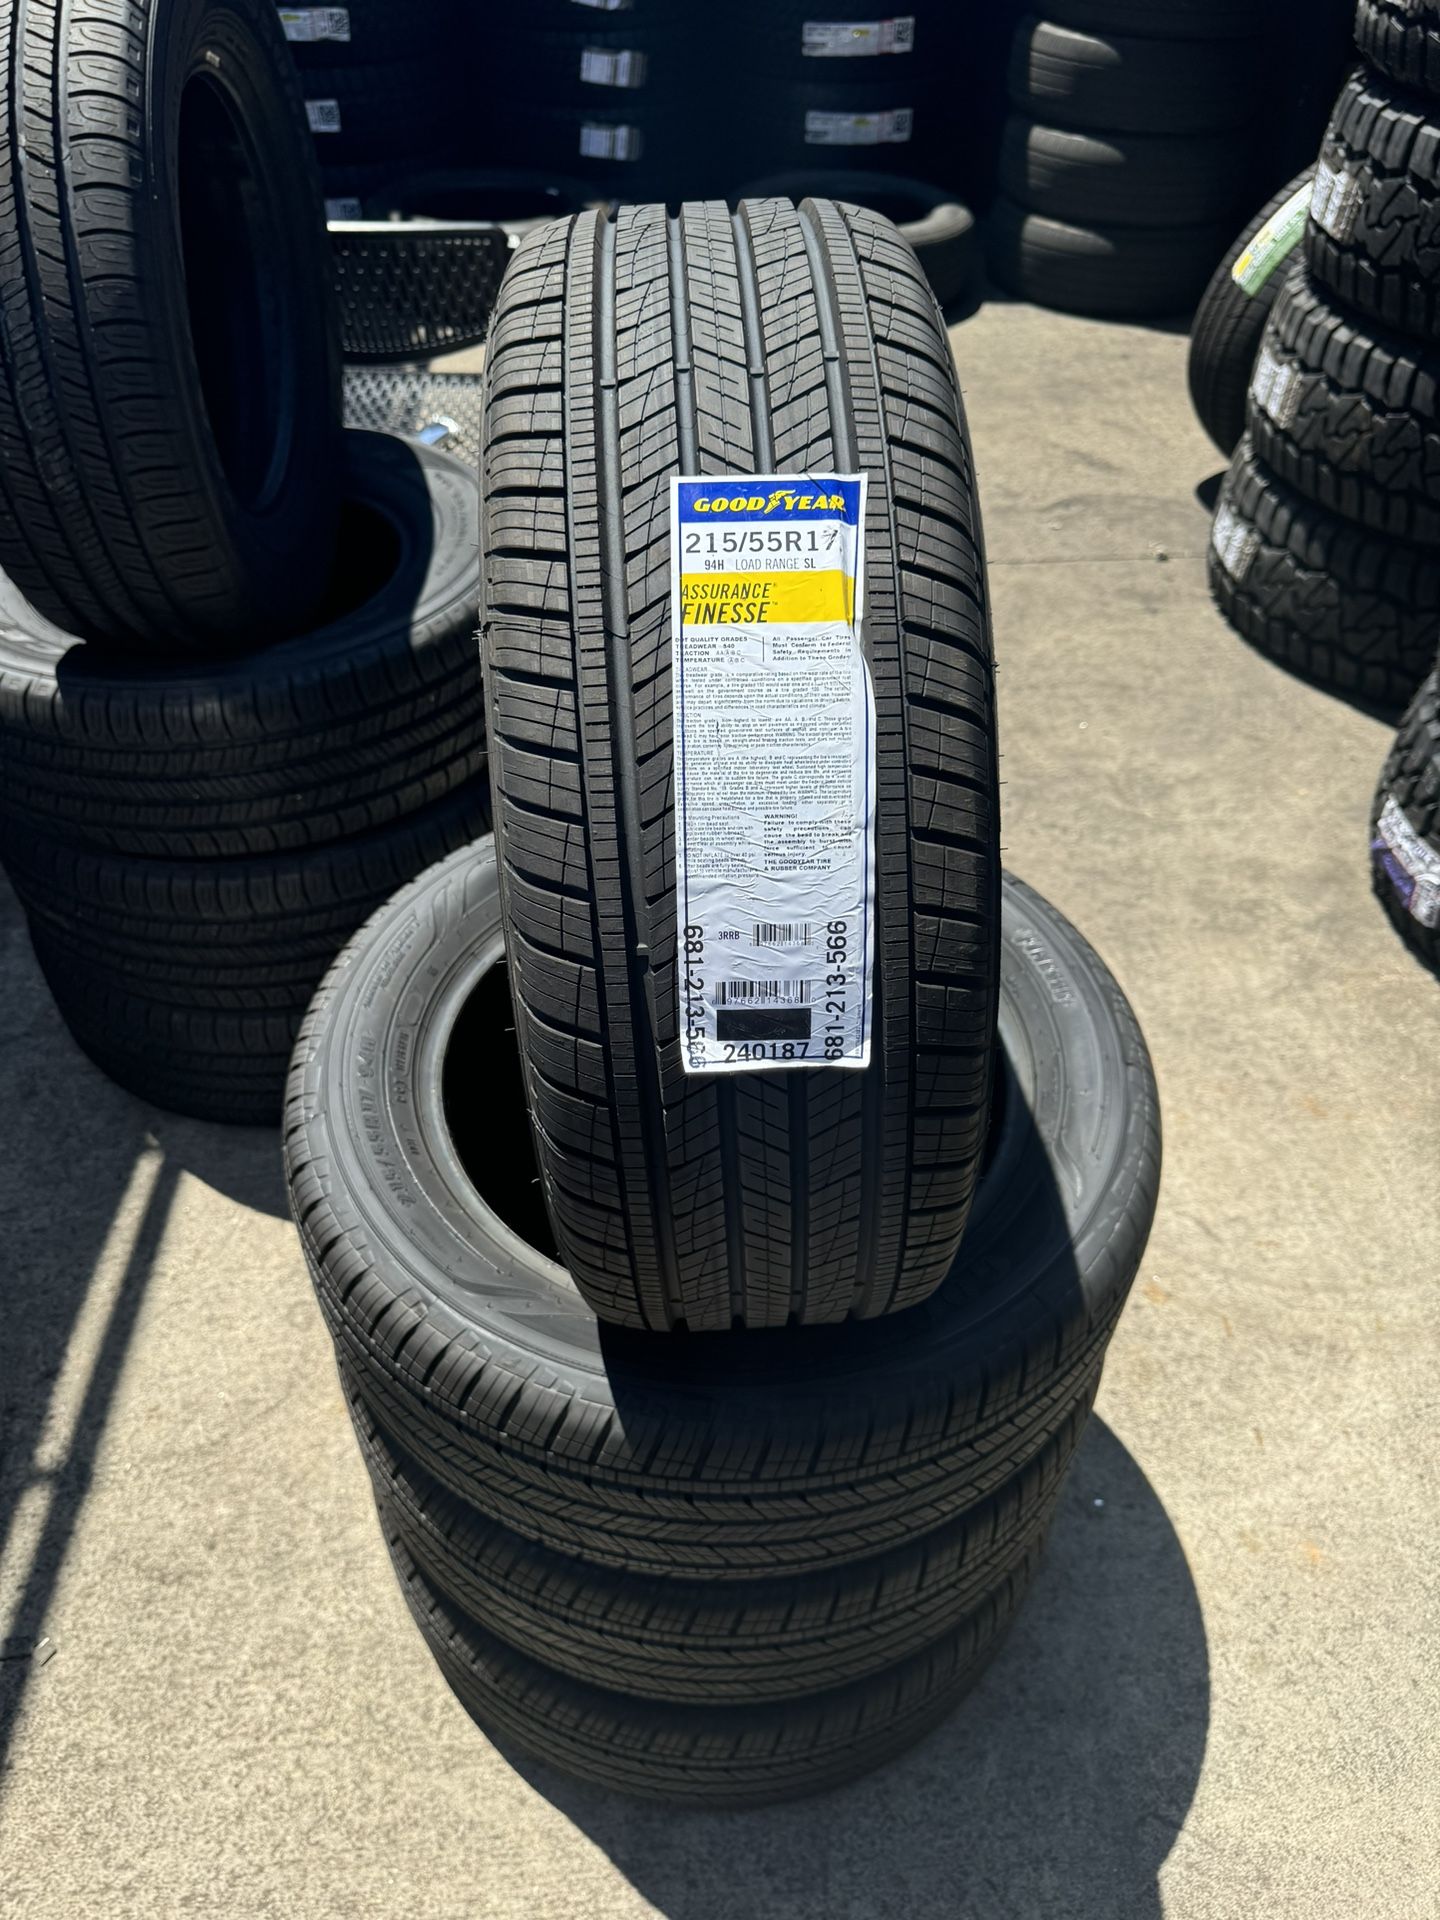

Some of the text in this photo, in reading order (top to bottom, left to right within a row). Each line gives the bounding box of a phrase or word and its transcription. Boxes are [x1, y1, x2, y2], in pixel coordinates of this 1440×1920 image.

[693, 494, 846, 513] GOODYEAR
[686, 529, 839, 554] 215/55R17
[704, 558, 816, 571] 94H LOAD RANGE SL
[682, 582, 772, 600] ASSURANCE
[682, 601, 770, 624] FINESSE
[718, 931, 740, 940] 3RRB
[684, 926, 706, 1068] 681-213-566
[824, 920, 847, 1060] 681-213-566
[723, 1042, 809, 1064] 240187
